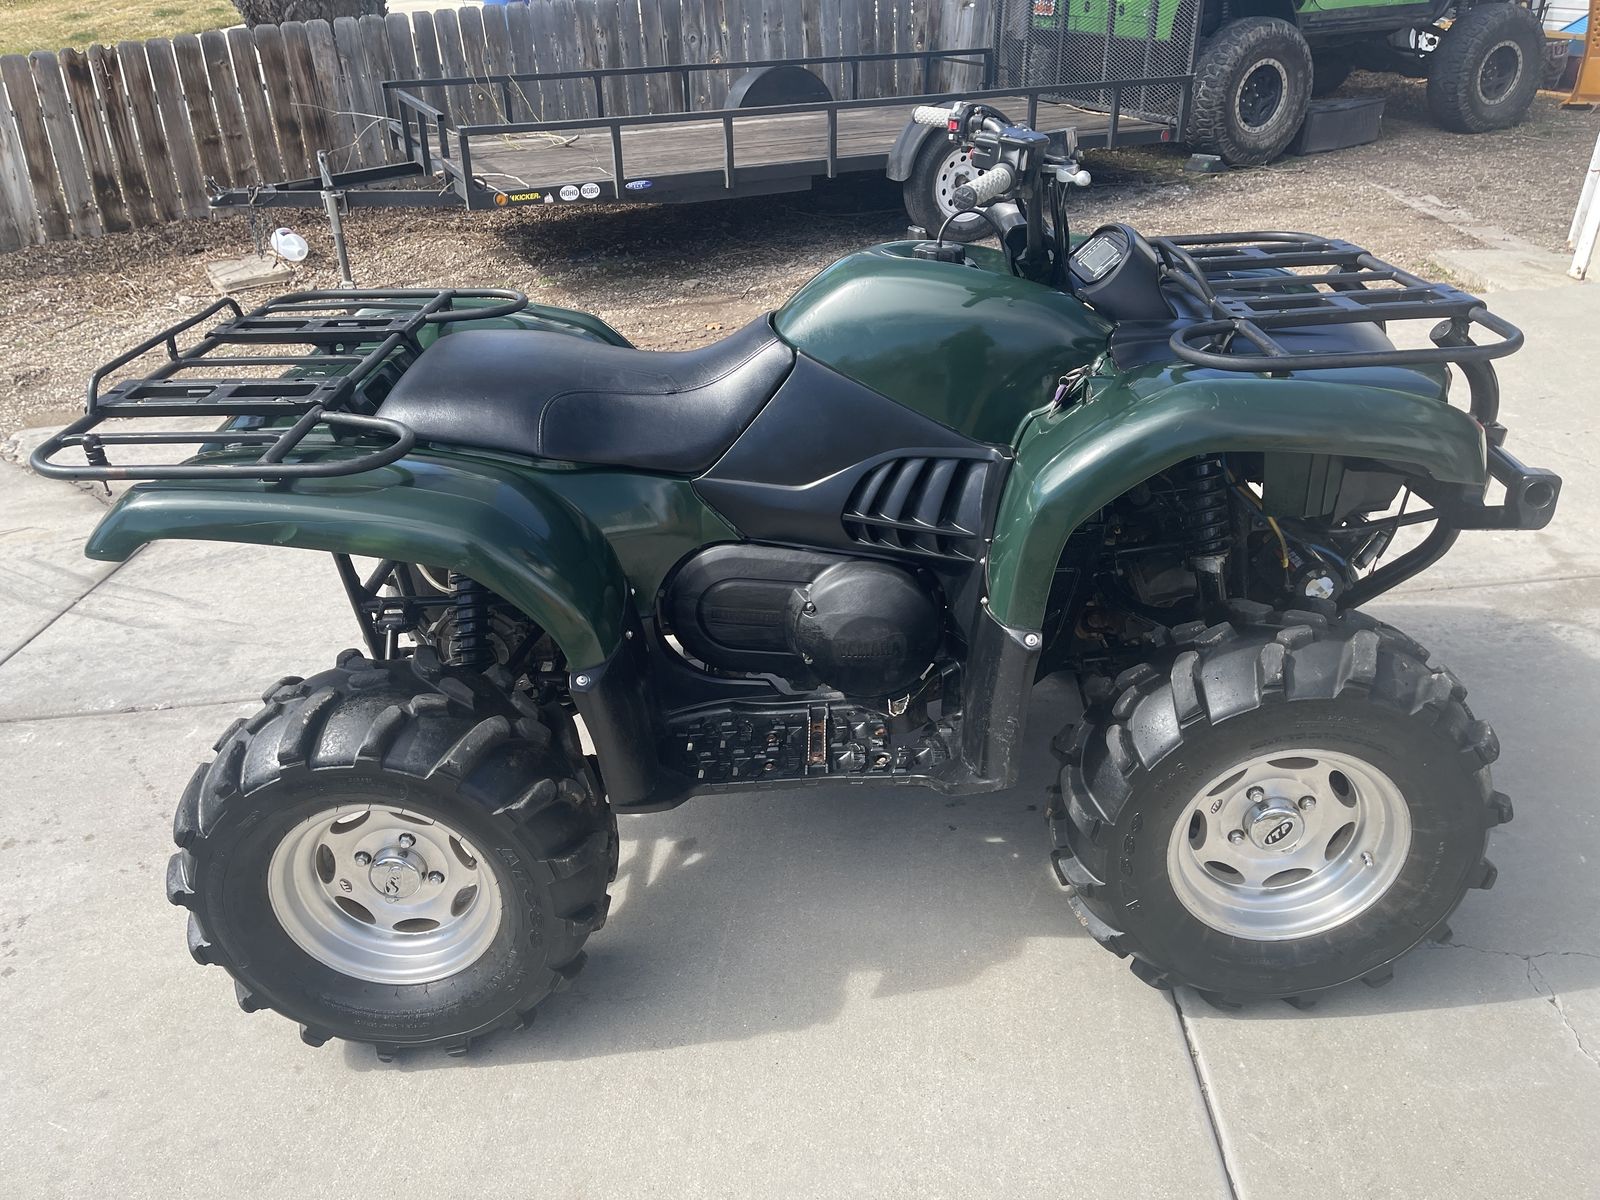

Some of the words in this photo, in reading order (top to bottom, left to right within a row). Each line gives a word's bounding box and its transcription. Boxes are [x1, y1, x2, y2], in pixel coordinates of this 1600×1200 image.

[561, 189, 578, 197] HOHO
[582, 186, 599, 195] BOBO
[1267, 823, 1290, 844] ITP
